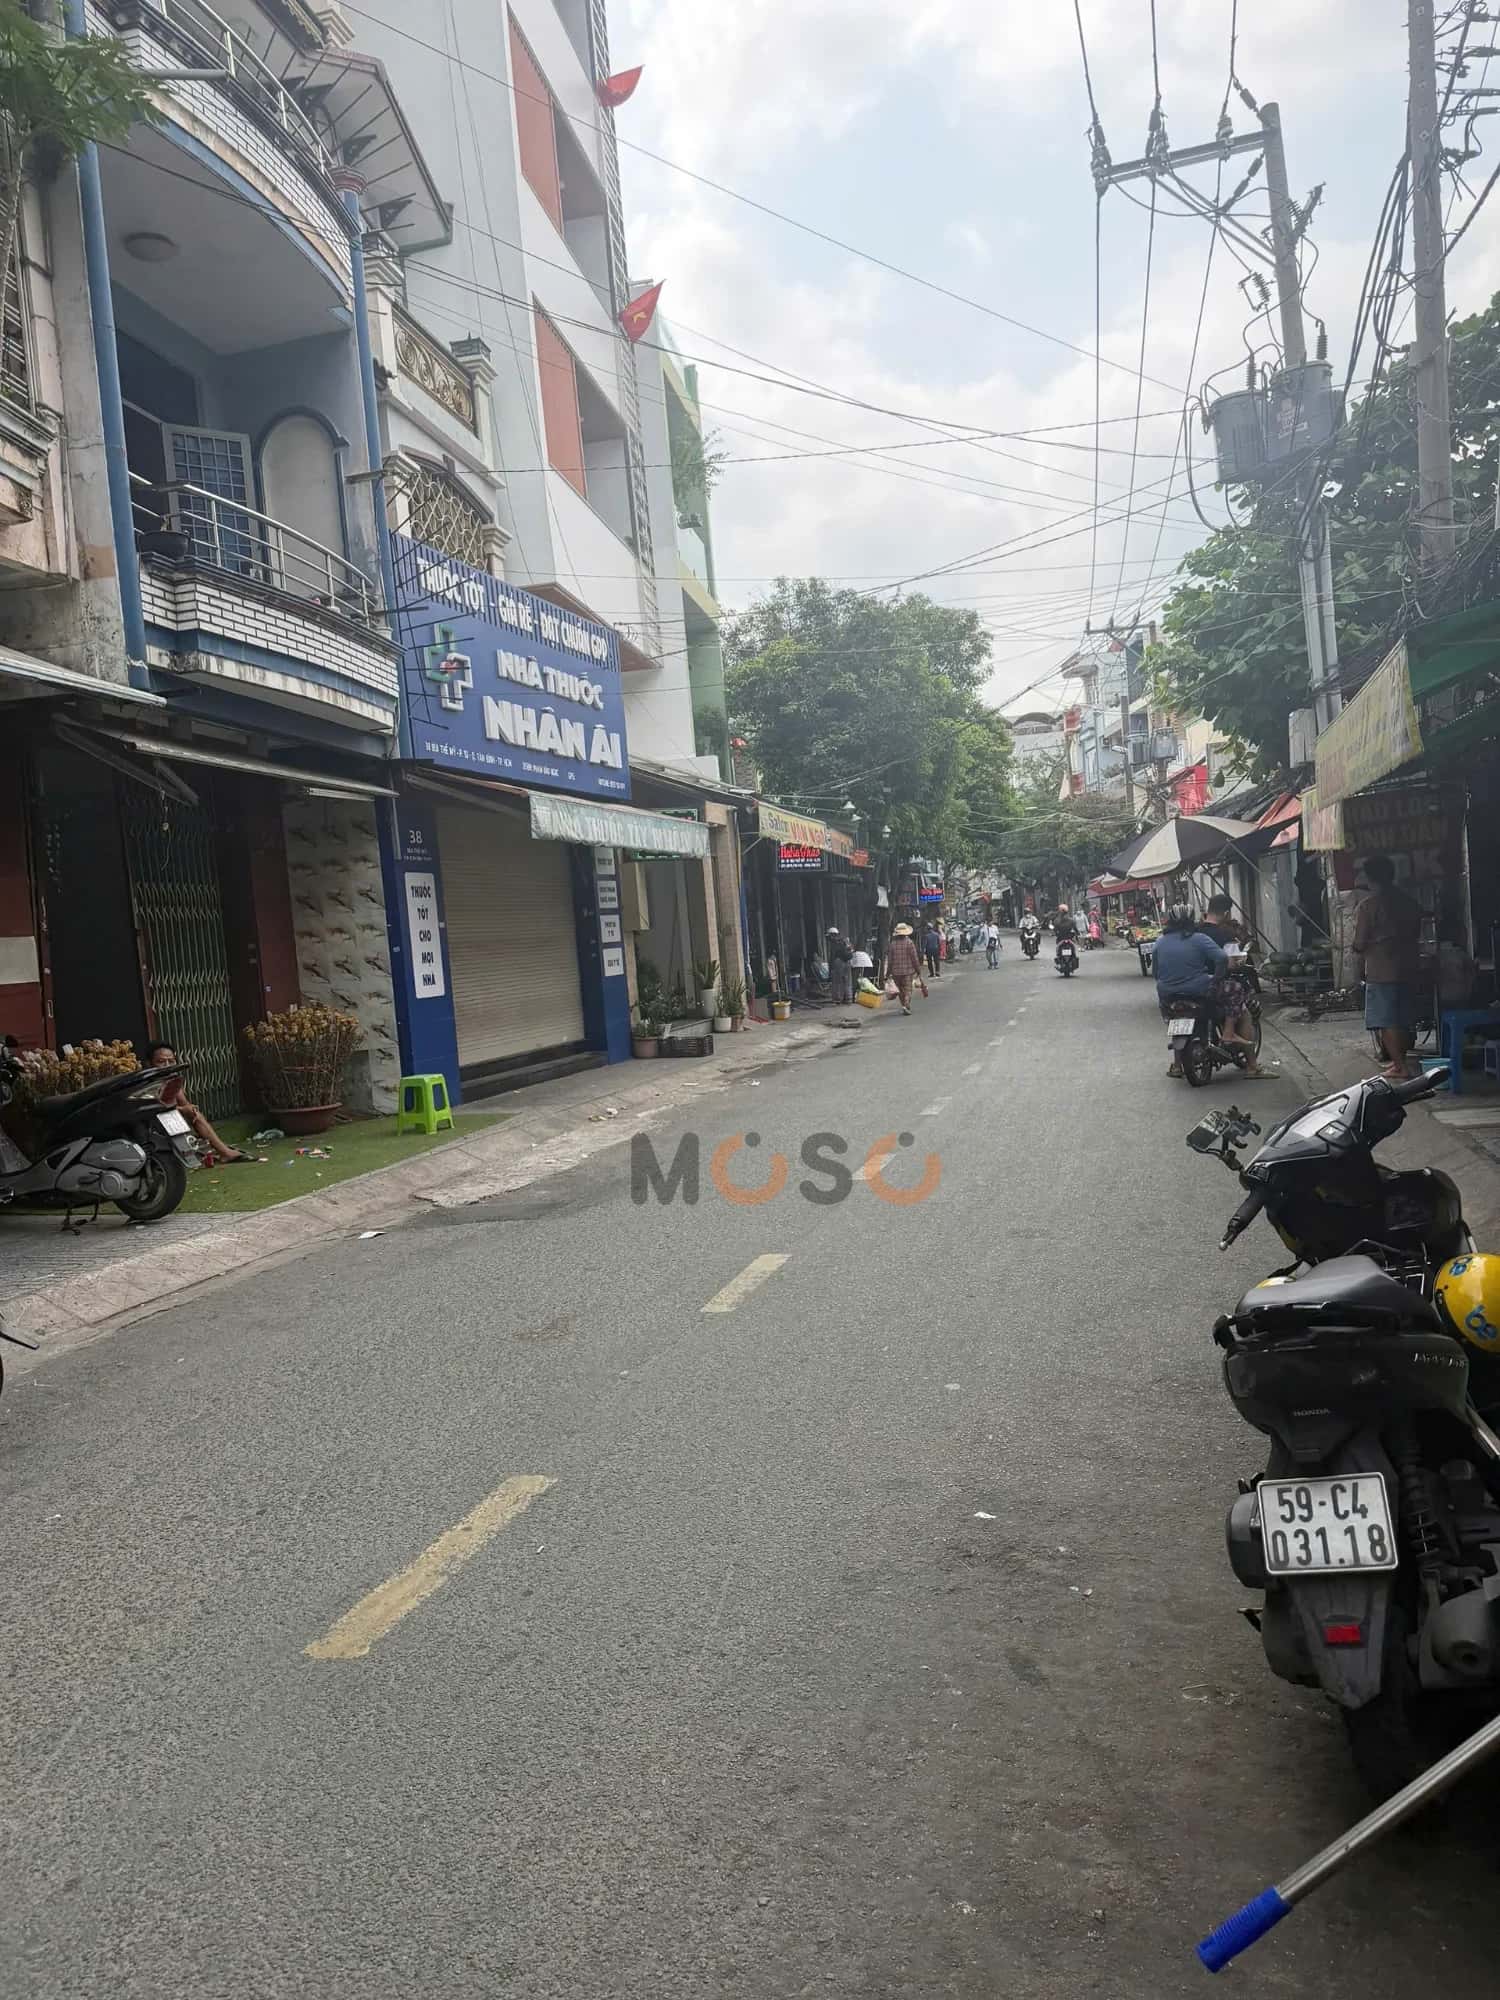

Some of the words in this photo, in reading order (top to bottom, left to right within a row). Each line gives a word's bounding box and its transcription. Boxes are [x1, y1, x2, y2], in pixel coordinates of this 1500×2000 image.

[483, 695, 587, 760] NHÂN
[409, 830, 423, 844] 38
[418, 929, 432, 942] CHO
[1277, 1482, 1369, 1524] 59-C4
[1272, 1524, 1388, 1567] 031.18
